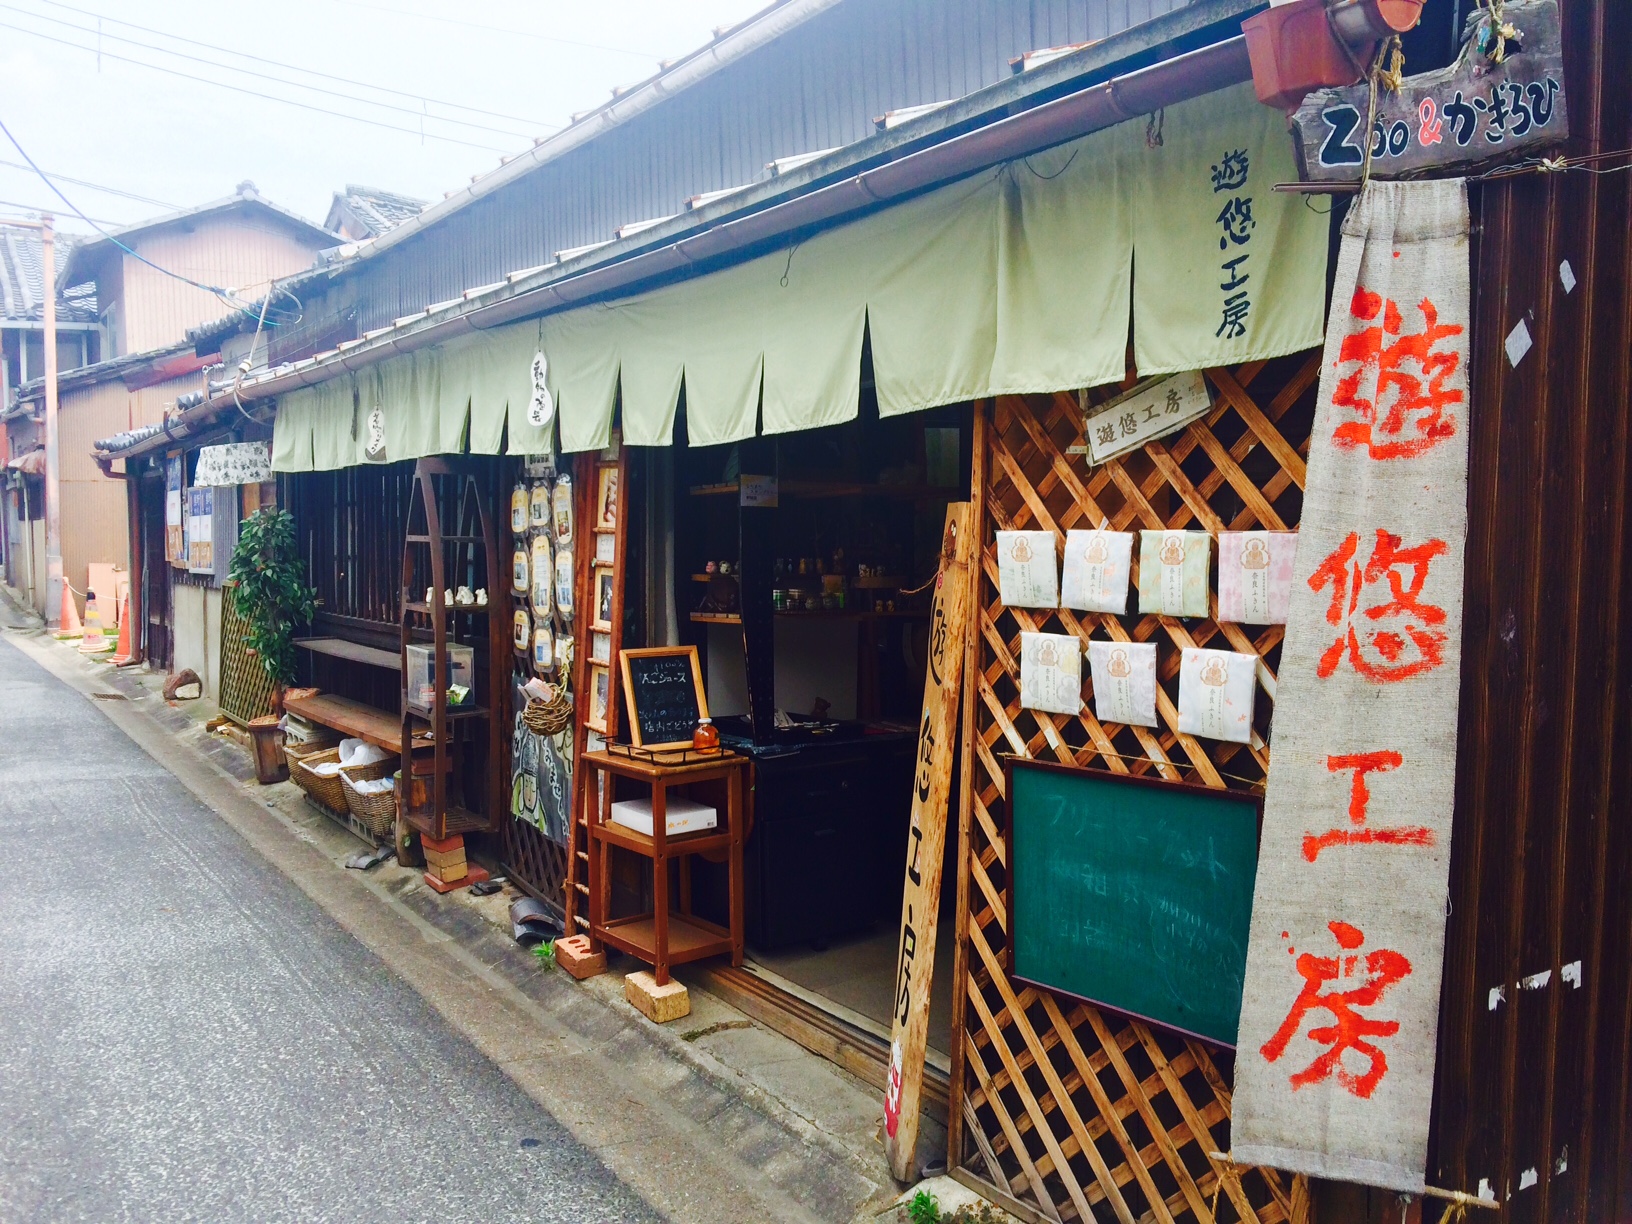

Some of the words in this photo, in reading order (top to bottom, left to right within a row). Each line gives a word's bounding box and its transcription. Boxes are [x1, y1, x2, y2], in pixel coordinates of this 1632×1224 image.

[1320, 103, 1410, 168] Zoo
[1417, 97, 1442, 146] &
[1442, 77, 1560, 146] かぎろひ
[1211, 149, 1256, 339] 遊悠工房
[1096, 387, 1183, 447] 遊悠工房
[1208, 688, 1216, 728] 奈良ふきん
[1261, 286, 1464, 1098] 遊悠工房
